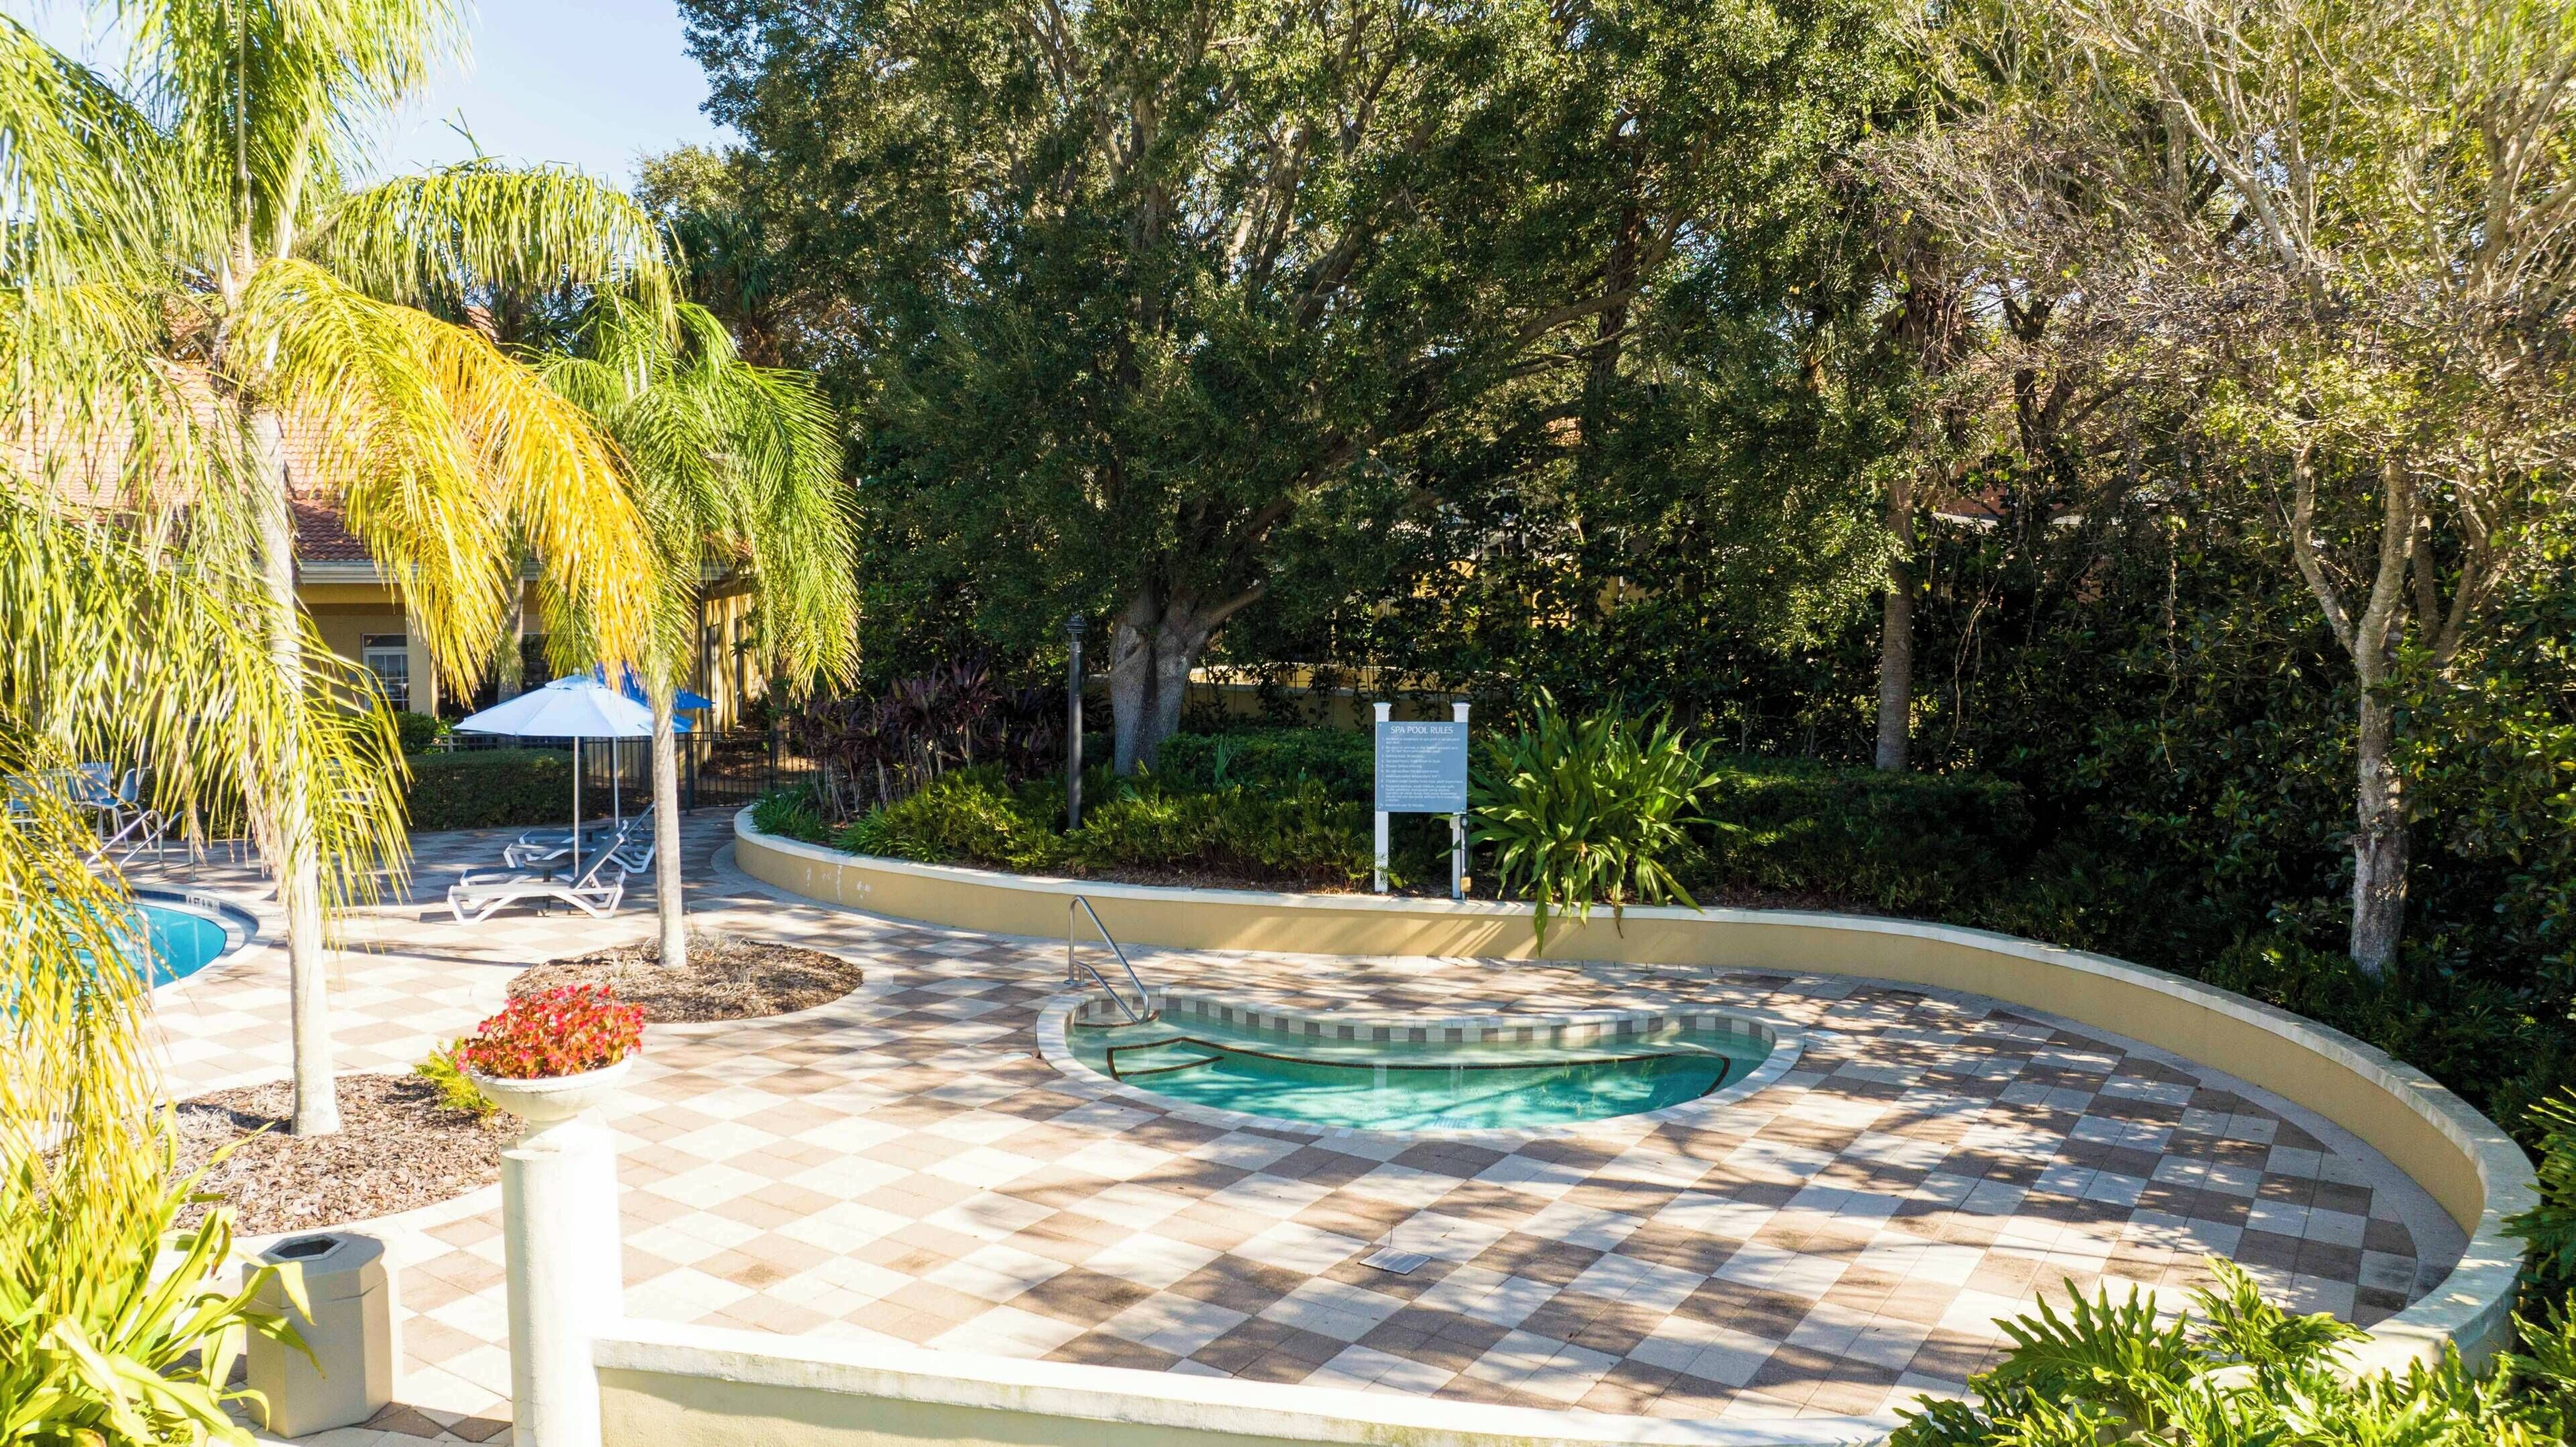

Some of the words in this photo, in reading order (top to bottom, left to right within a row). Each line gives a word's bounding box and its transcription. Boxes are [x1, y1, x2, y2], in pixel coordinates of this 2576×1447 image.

[1391, 726, 1405, 735] SPA
[1407, 726, 1428, 735] POOL
[1430, 726, 1454, 735] RULES
